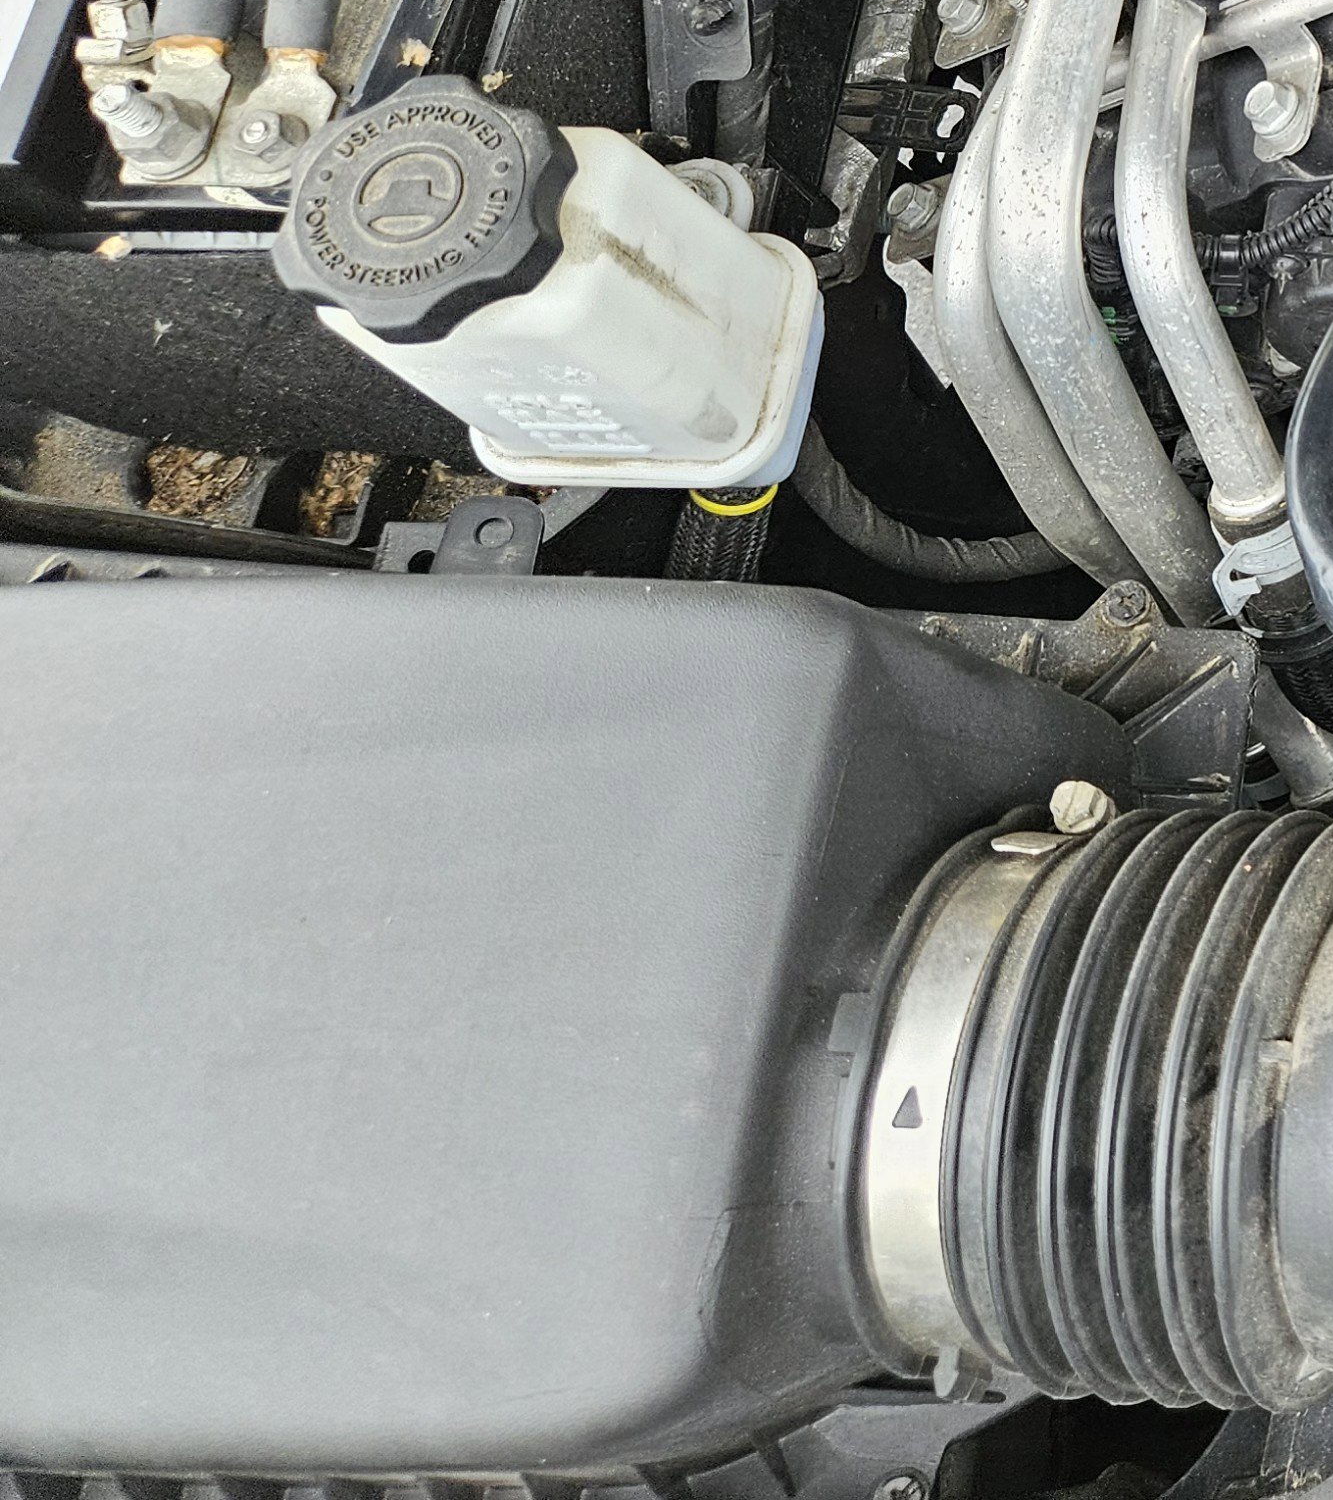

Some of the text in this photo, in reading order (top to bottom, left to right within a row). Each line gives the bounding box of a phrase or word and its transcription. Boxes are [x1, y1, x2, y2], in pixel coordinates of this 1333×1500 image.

[336, 103, 503, 159] USE APPROVED
[305, 187, 509, 287] POWER STEERING FLUID
